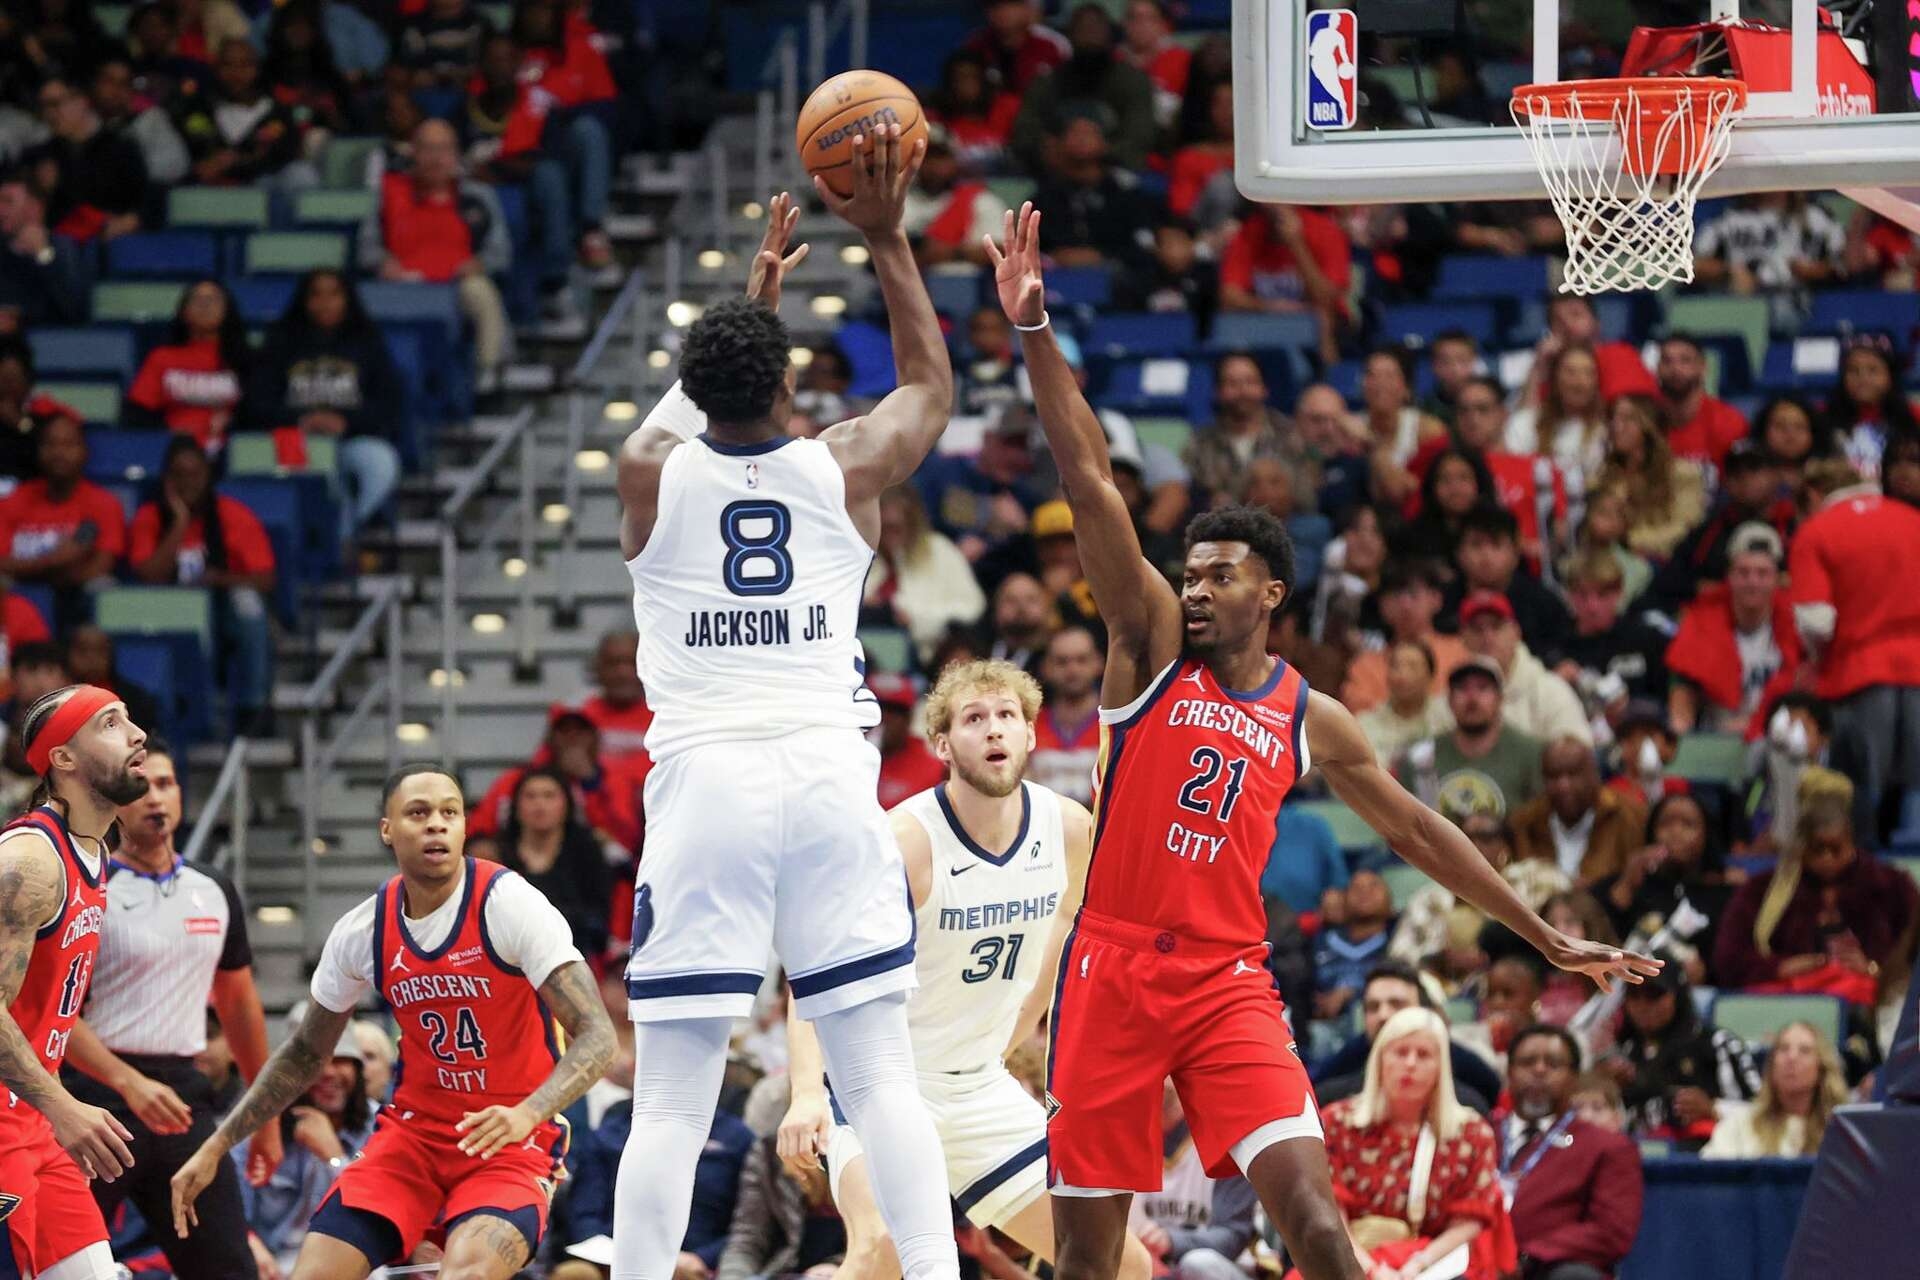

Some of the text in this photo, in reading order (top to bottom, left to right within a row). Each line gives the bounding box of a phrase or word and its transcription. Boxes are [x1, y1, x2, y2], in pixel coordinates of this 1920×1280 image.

[1312, 101, 1338, 122] NBA
[720, 499, 794, 597] 8
[685, 604, 833, 647] JACKSON JR.
[1167, 699, 1284, 769] CRESCENT
[1253, 703, 1292, 723] NEWAGE
[1177, 745, 1249, 823] 21
[1166, 822, 1227, 864] CITY
[939, 891, 1057, 931] MEMPHIS
[961, 933, 1024, 984] 31
[390, 974, 492, 1008] CRESCENT
[419, 1006, 487, 1063] 24
[437, 1067, 486, 1092] CITY
